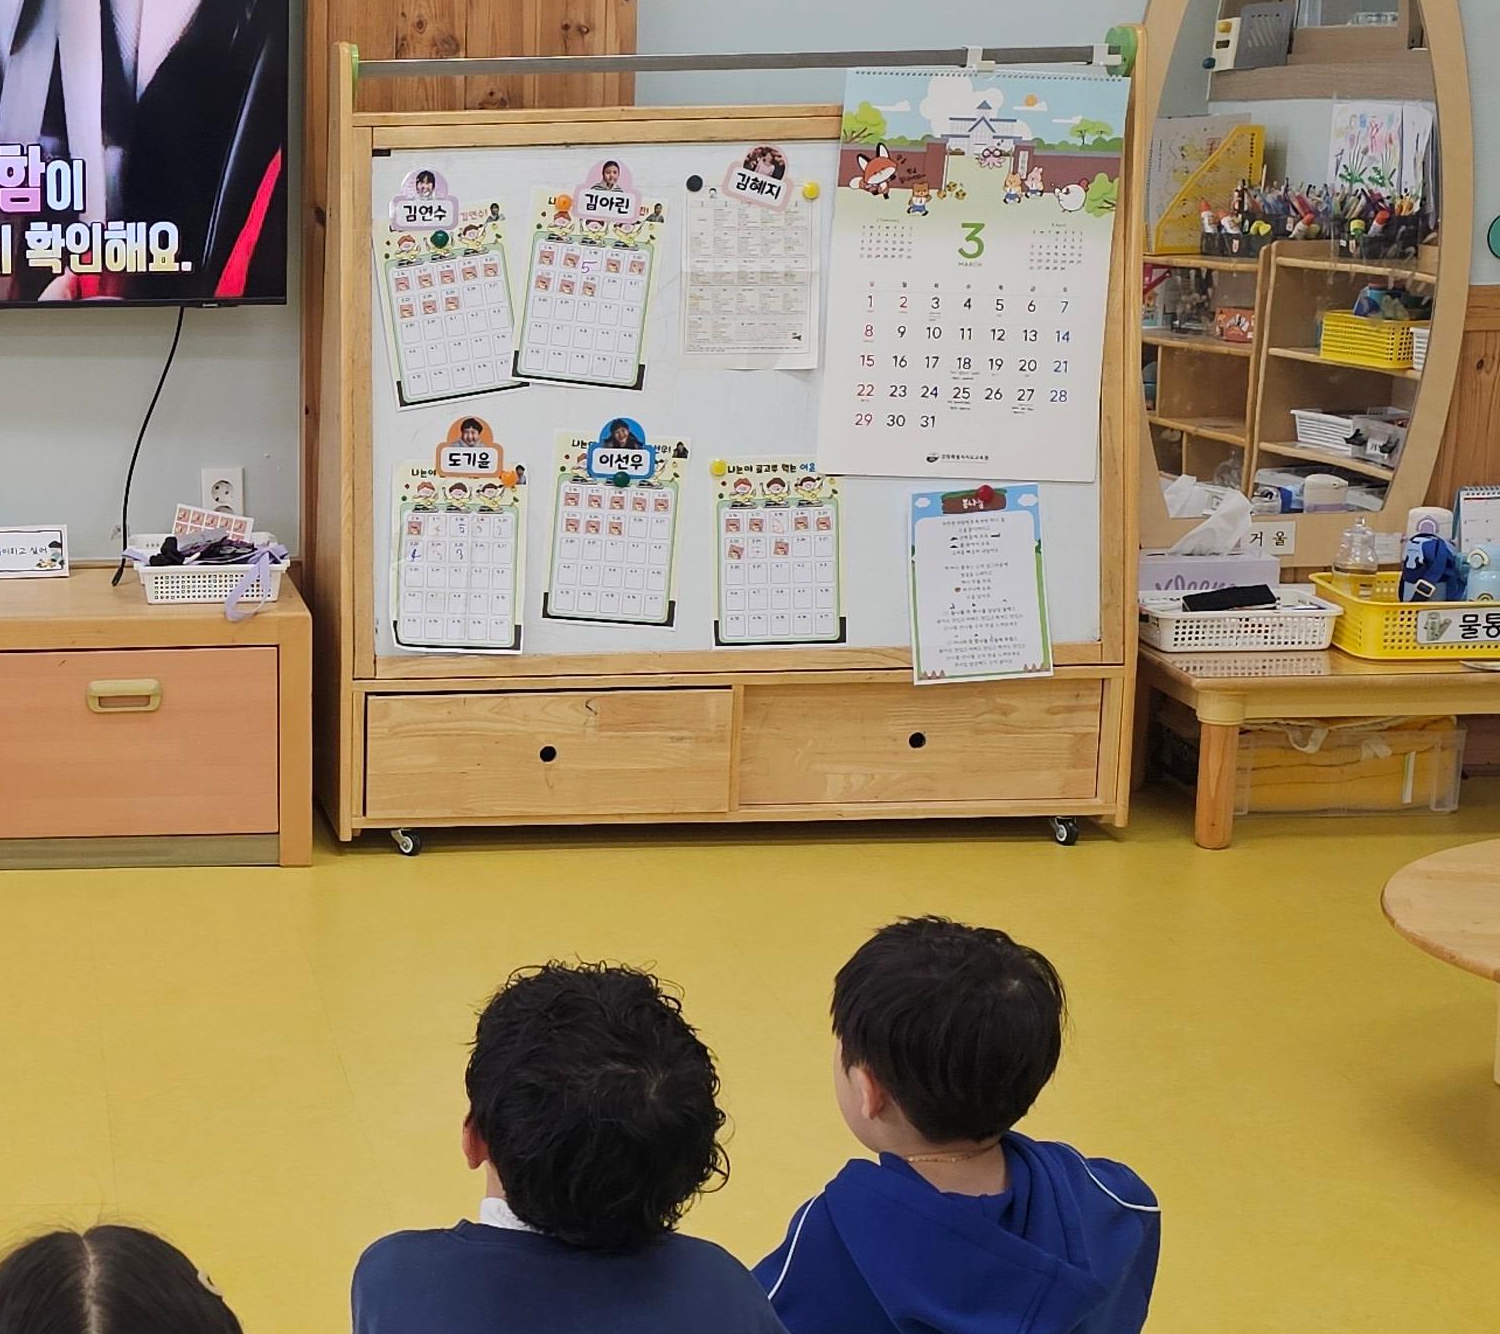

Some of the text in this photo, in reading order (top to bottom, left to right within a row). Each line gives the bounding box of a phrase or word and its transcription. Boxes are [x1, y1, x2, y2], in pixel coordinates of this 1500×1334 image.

[735, 173, 782, 200] 김혜지
[585, 194, 630, 214] 김아린
[403, 205, 447, 222] 김연수
[25, 220, 195, 276] 확인해요.
[958, 223, 985, 259] 3
[581, 261, 598, 273] 5
[867, 295, 1069, 313] 1 2 3 4 5 6 7
[865, 325, 1070, 343] 8 9 10 11 12 13 14
[860, 355, 1068, 373] 15 16 17 18 19 20 21
[857, 384, 1068, 402] 22 23 24 25 26 27 28
[855, 414, 935, 428] 29 30 31
[449, 453, 492, 468] 도기윤
[599, 454, 644, 470] 이선우
